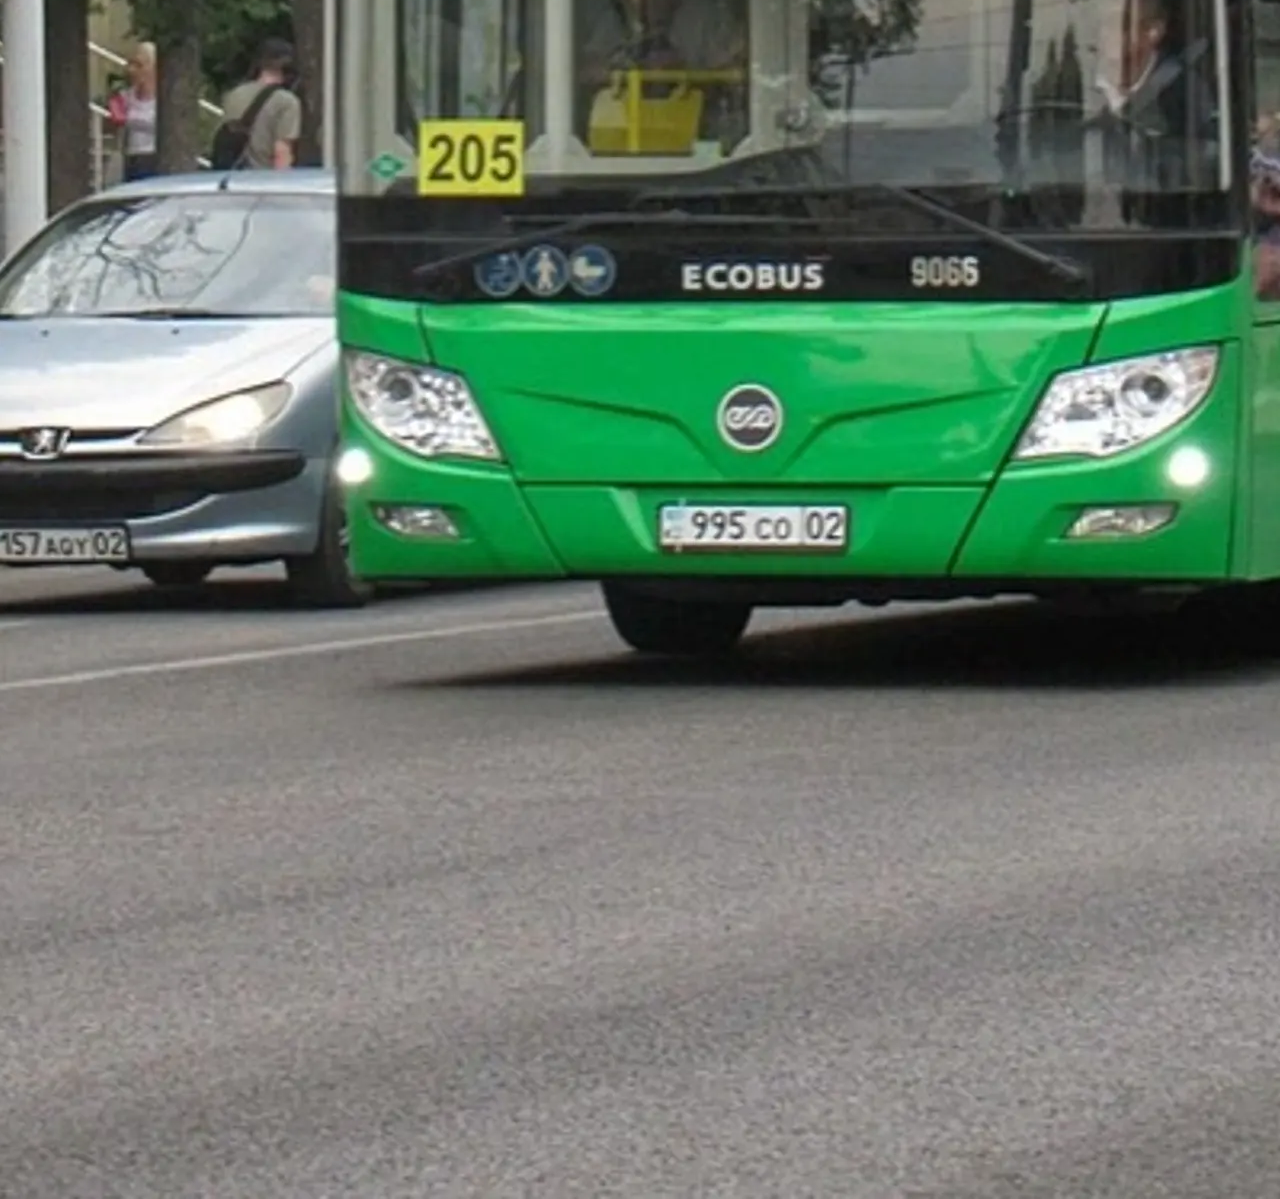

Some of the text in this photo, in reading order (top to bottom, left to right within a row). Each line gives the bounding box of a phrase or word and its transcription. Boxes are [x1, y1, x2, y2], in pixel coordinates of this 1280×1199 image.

[427, 133, 518, 182] 205
[681, 263, 824, 291] ECOBUS
[691, 510, 746, 540] 995
[806, 511, 843, 541] 02
